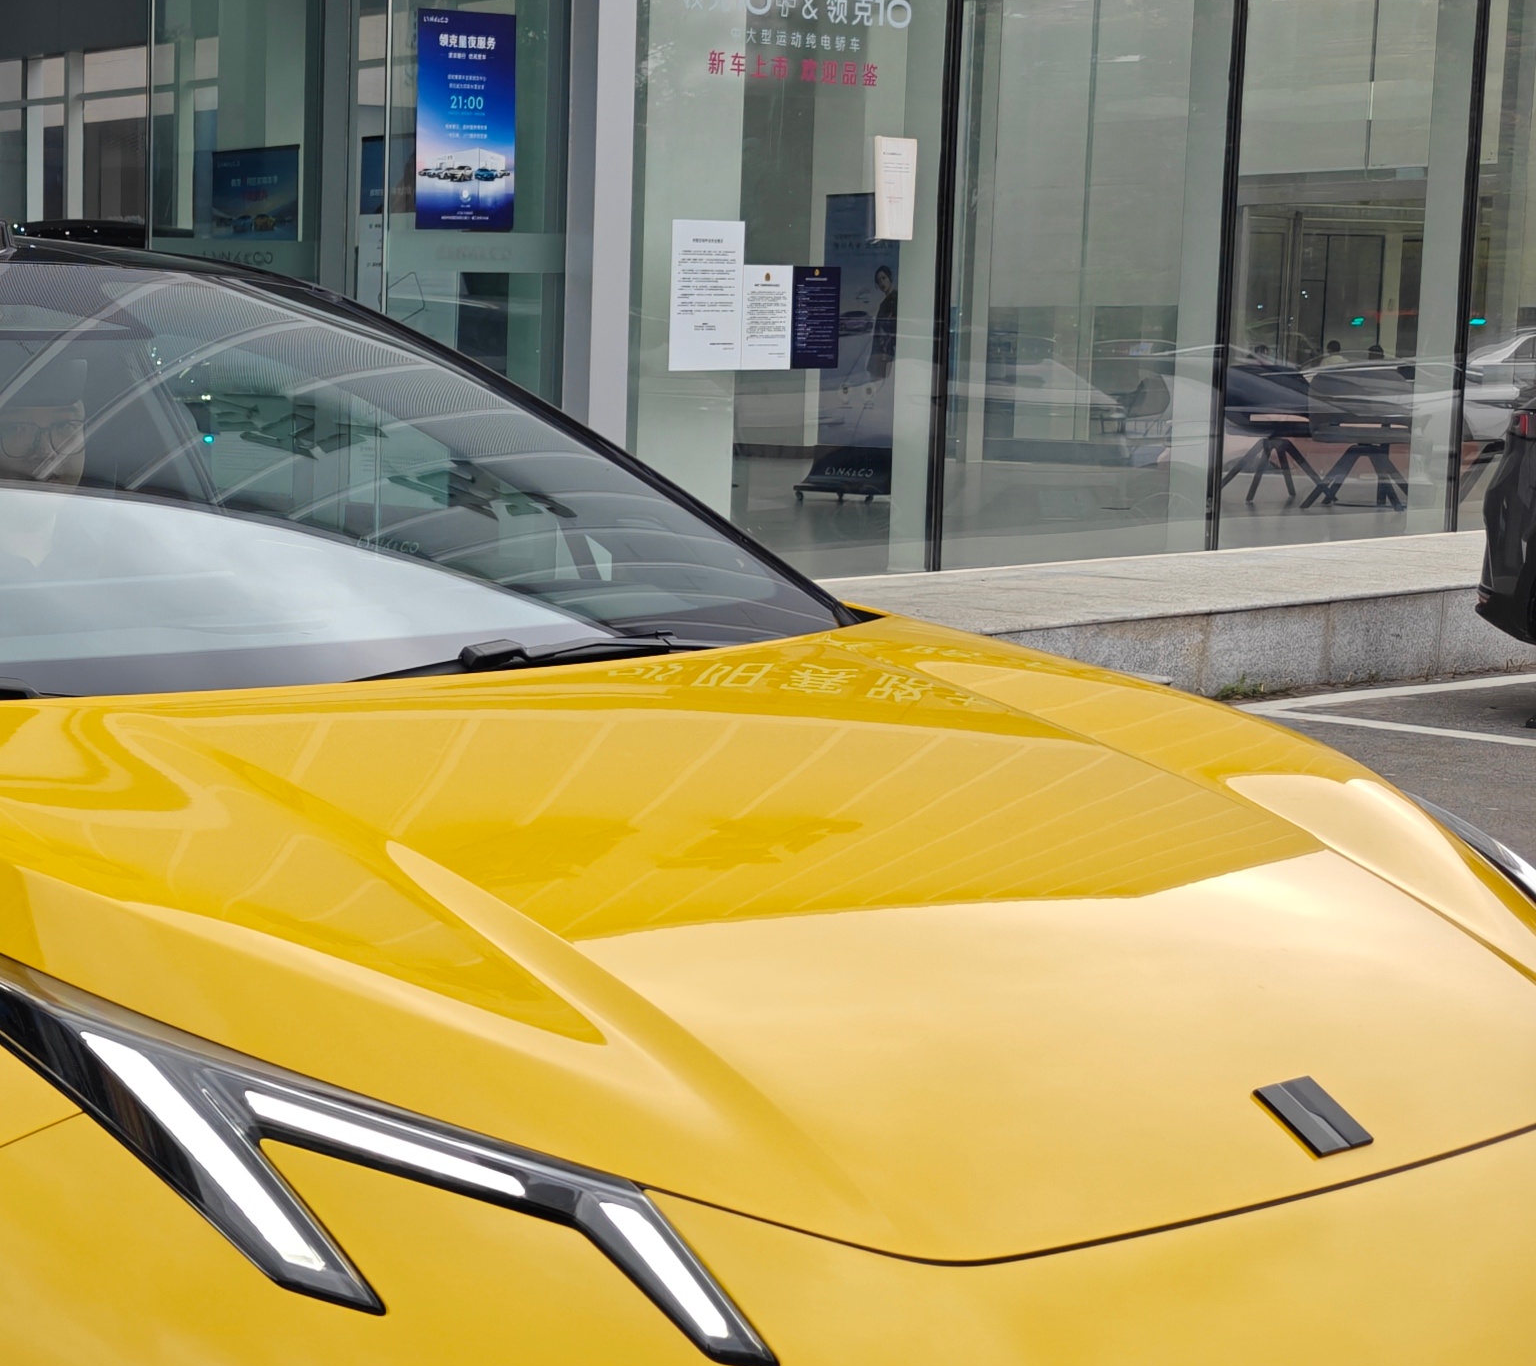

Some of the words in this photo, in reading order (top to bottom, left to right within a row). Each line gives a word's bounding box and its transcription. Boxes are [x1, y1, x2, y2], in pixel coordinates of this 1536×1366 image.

[731, 27, 862, 54] 中大型运动纯电轿车
[707, 50, 790, 79] 新车上市
[800, 59, 879, 87] 欢迎品鉴
[450, 95, 485, 110] 21:00
